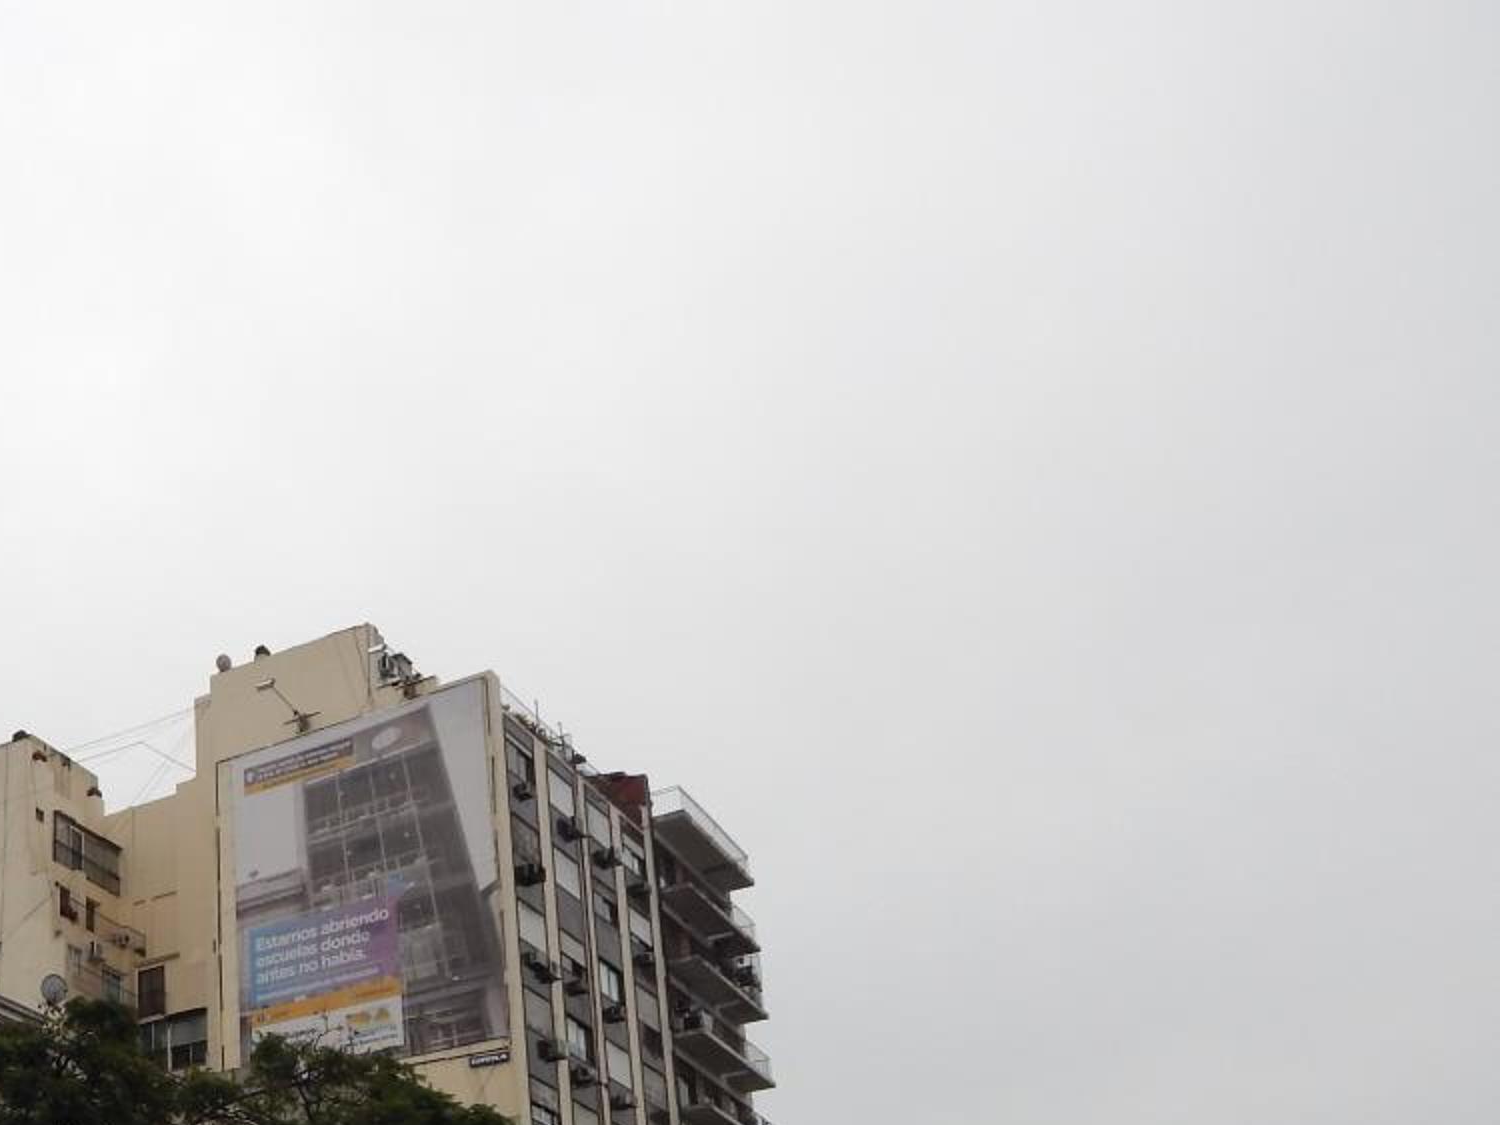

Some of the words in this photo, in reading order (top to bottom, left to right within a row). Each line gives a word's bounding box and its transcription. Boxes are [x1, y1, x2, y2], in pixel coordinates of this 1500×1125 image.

[256, 928, 318, 951] Estamos
[321, 908, 389, 934] abriendo
[257, 944, 318, 967] escuelas
[321, 930, 370, 951] donde
[257, 965, 296, 985] antes
[299, 961, 319, 973] no
